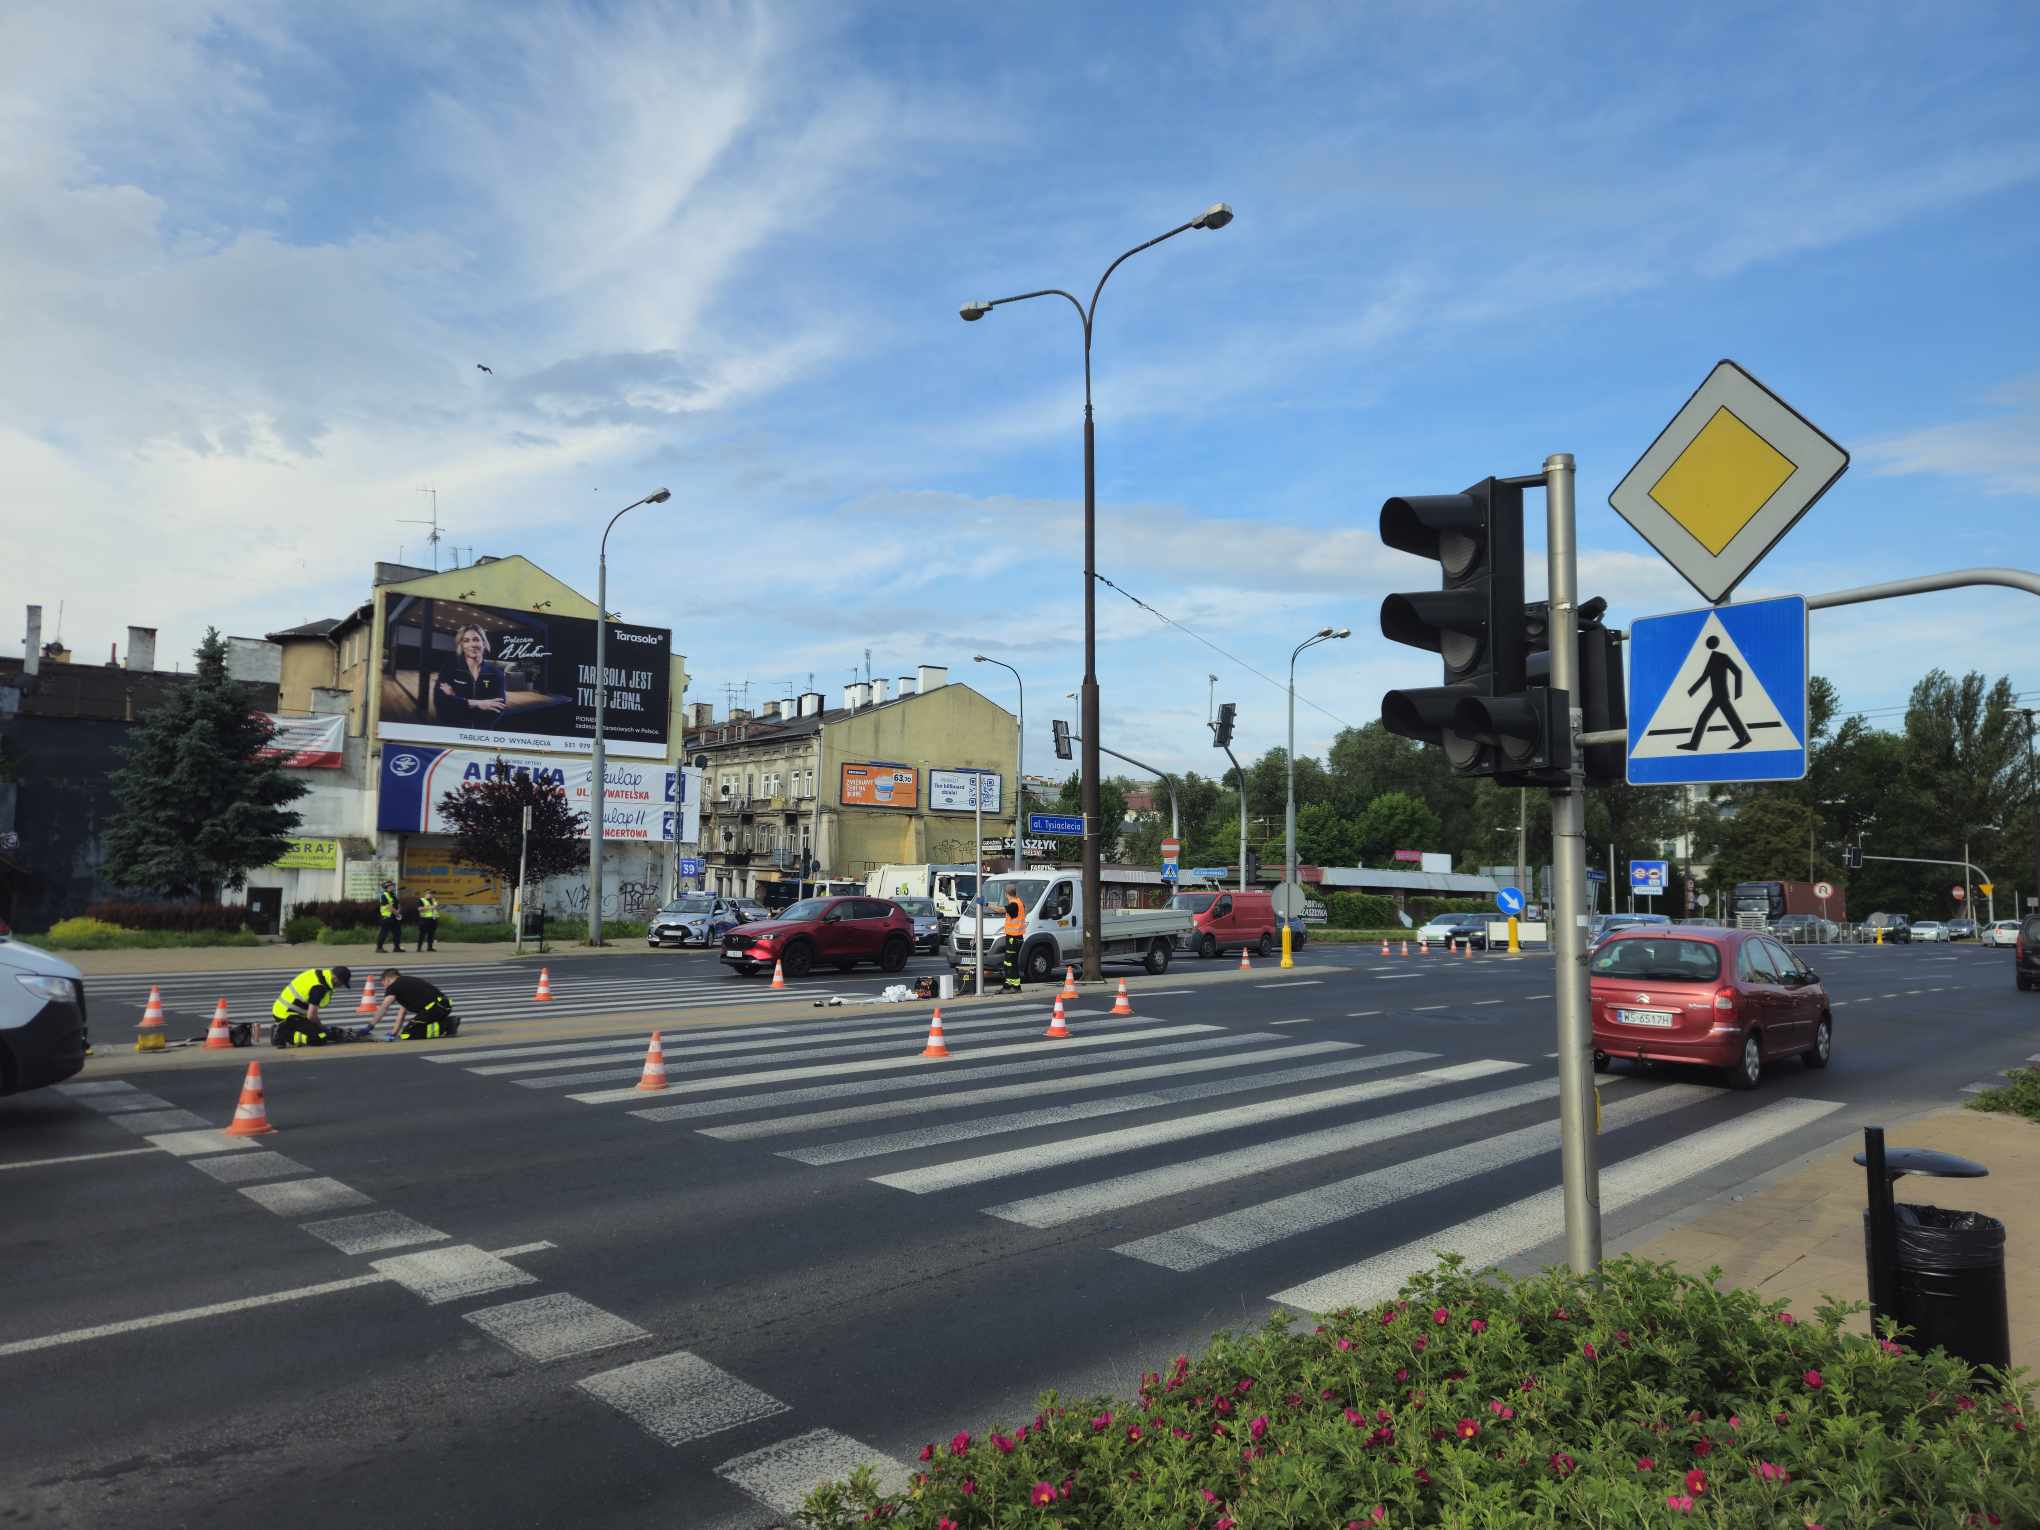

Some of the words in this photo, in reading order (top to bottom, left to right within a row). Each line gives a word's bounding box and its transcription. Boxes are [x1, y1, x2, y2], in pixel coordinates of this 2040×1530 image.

[578, 664, 626, 687] TARSOLA
[626, 670, 654, 690] JEST
[577, 688, 607, 708] TYLO
[458, 733, 489, 742] TABLICA
[493, 735, 506, 743] DO
[1033, 819, 1043, 829] al.
[1044, 819, 1081, 832] Tysiąclecia
[683, 863, 695, 874] 39
[1624, 1011, 1637, 1023] WS
